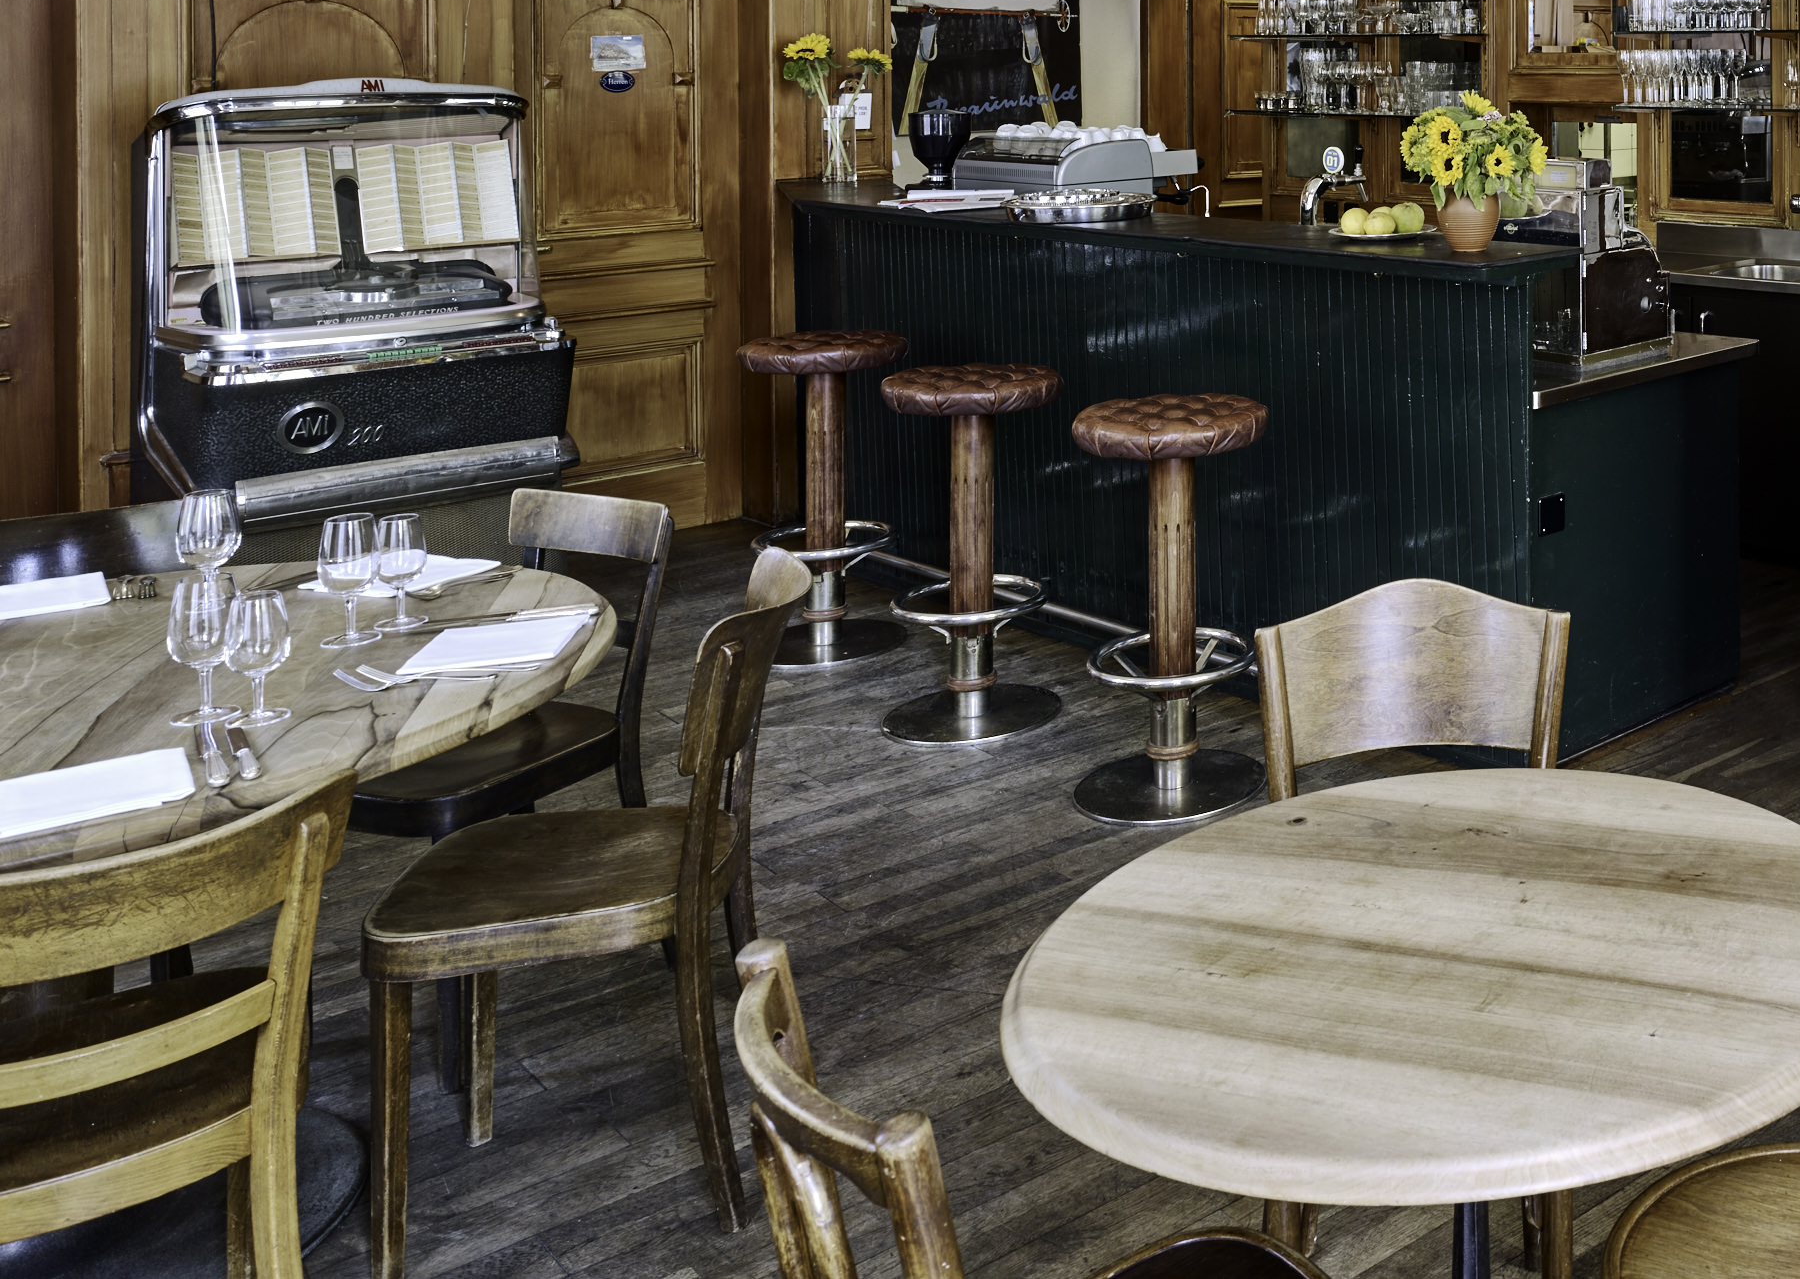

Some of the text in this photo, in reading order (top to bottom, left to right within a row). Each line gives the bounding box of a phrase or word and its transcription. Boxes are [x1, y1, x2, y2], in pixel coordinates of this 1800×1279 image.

[361, 79, 385, 92] AMI
[316, 306, 459, 326] TWO HUNDRED SELECTIONS
[290, 414, 383, 446] AMI 200
